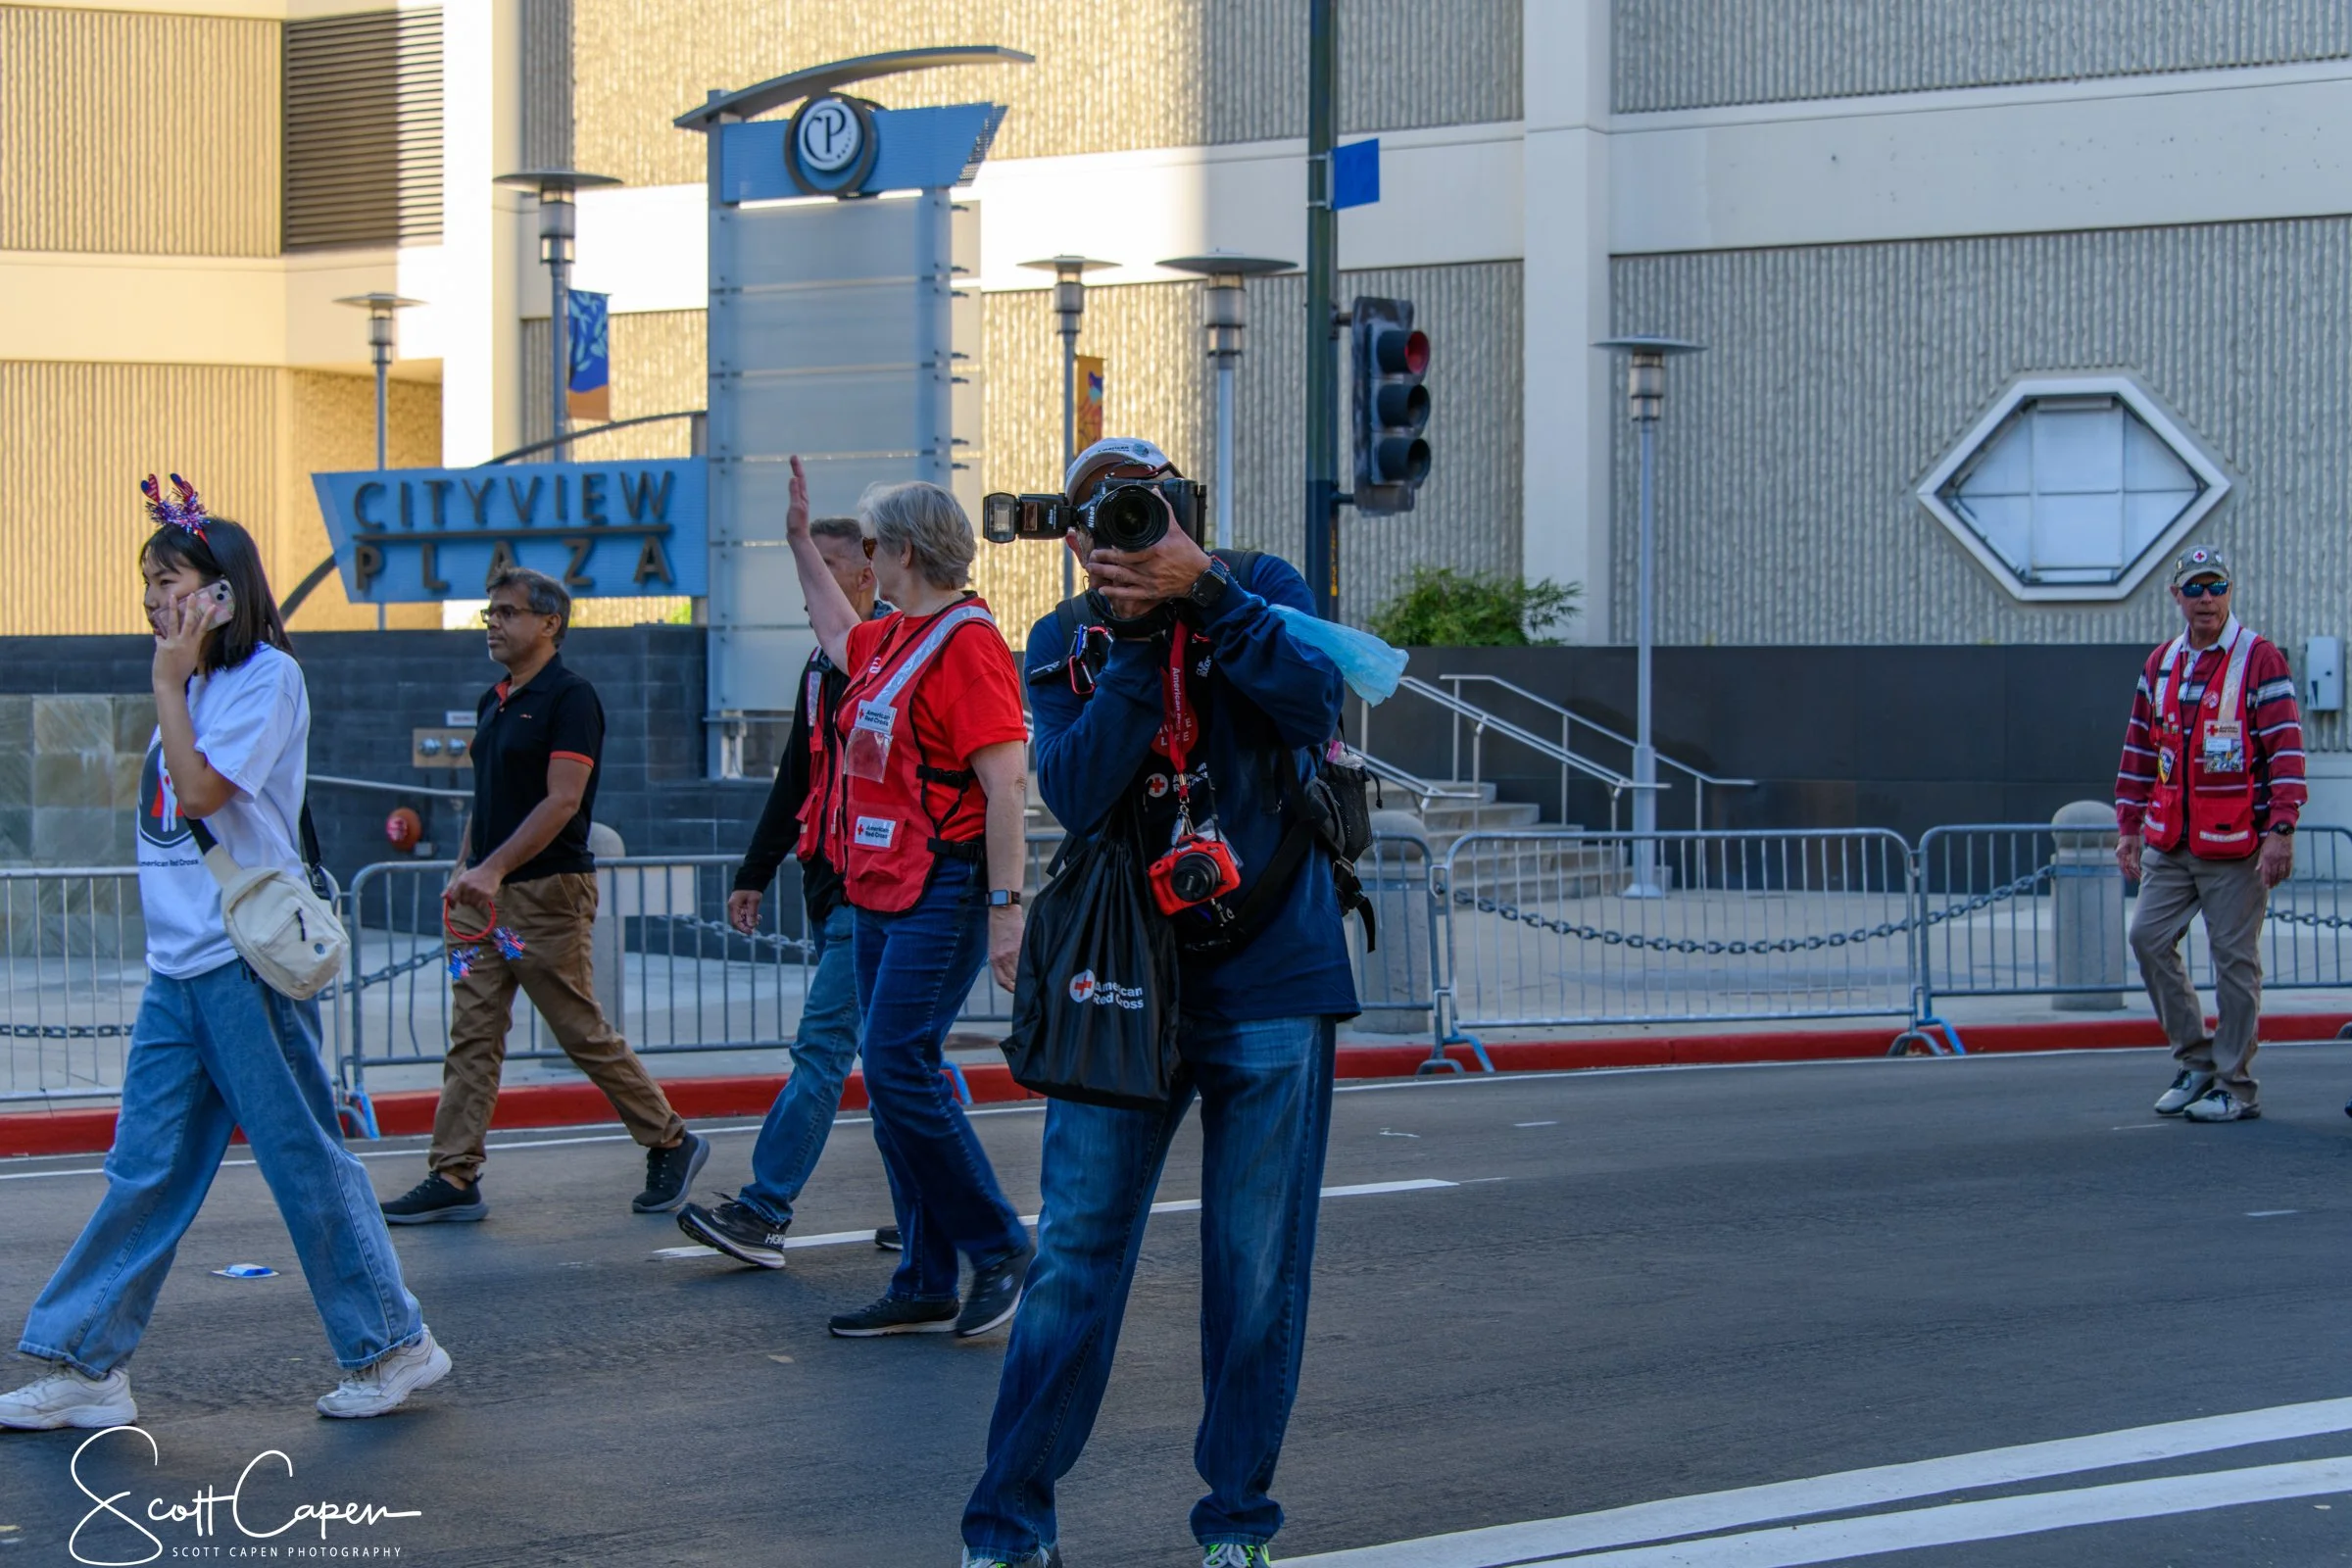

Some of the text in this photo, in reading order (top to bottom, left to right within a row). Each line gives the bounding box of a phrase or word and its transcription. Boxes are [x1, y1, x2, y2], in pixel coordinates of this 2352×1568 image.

[353, 469, 677, 531] CITYVIEW
[1087, 506, 1096, 528] Nikon
[355, 535, 676, 591] PLAZA
[1172, 667, 1181, 711] American
[864, 714, 874, 723] Red
[865, 710, 891, 721] American
[1093, 992, 1114, 1005] Red
